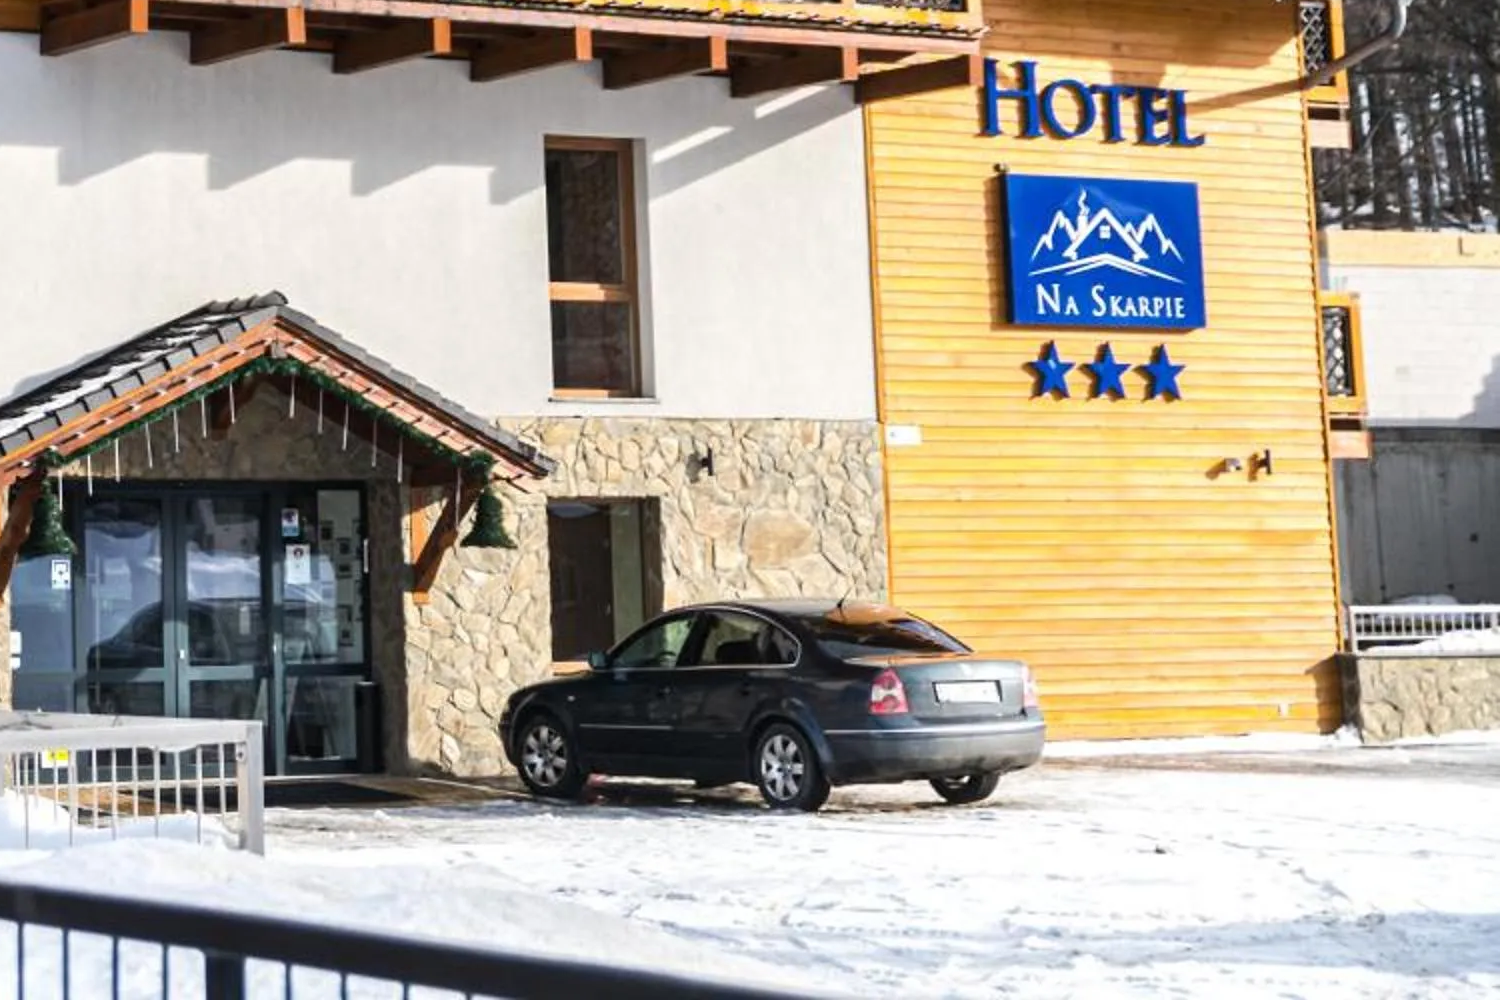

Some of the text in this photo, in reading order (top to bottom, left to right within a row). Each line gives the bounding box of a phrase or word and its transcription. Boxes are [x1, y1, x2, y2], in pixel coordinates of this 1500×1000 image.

[980, 58, 1206, 147] HOTEL
[1035, 282, 1187, 319] NA SKARPIE
